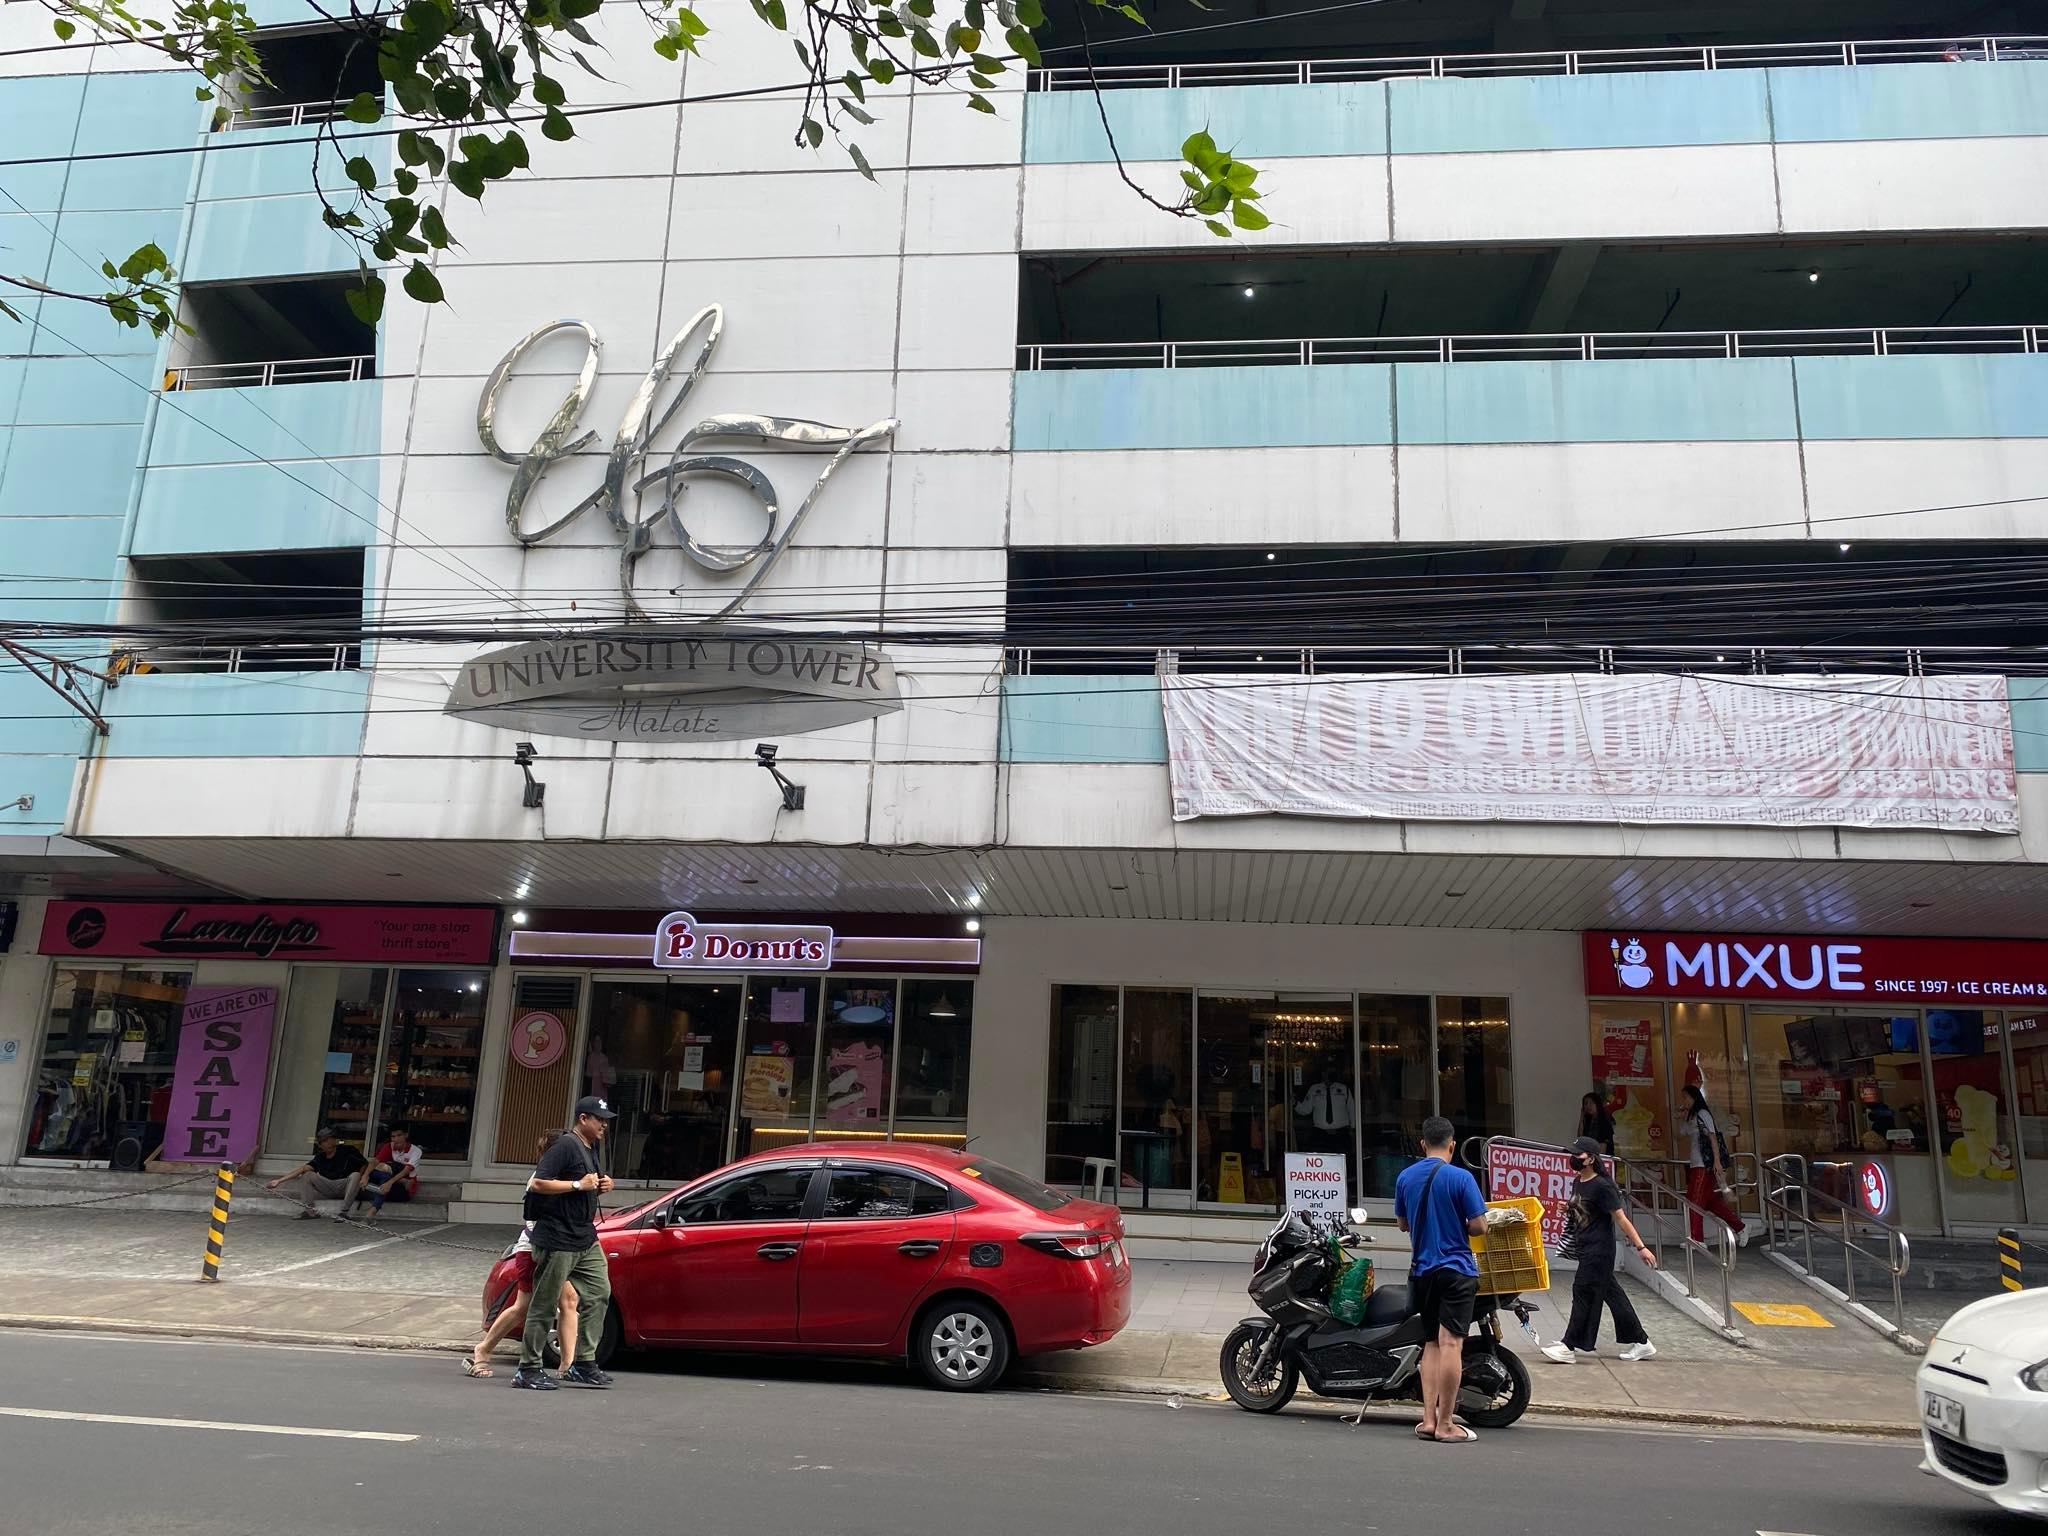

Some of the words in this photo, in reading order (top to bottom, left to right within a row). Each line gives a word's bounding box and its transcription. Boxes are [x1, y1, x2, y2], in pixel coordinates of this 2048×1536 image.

[469, 638, 701, 699] UNIVERSITY
[725, 638, 882, 692] TOWER
[412, 921, 437, 932] one
[440, 921, 470, 935] stop
[381, 937, 412, 949] thrift
[702, 934, 824, 961] Donuts
[1664, 941, 1866, 991] MIXUE
[1874, 979, 1916, 992] SINCE
[1920, 980, 1948, 993] 1997
[1957, 982, 1980, 994] ICE
[1983, 982, 2035, 995] CREAM
[2037, 984, 2048, 996] &
[188, 1004, 212, 1020] WE
[215, 997, 244, 1015] ARE
[248, 991, 269, 1006] ON
[184, 1021, 243, 1157] SALE
[1306, 1158, 1323, 1168] NO
[1492, 1149, 1570, 1173] COMMERCIAL
[1289, 1171, 1341, 1182] PARKING
[1492, 1167, 1541, 1197] FOR
[1547, 1174, 1575, 1200] RE
[1294, 1189, 1338, 1200] PICK-UP
[1309, 1201, 1323, 1209] and
